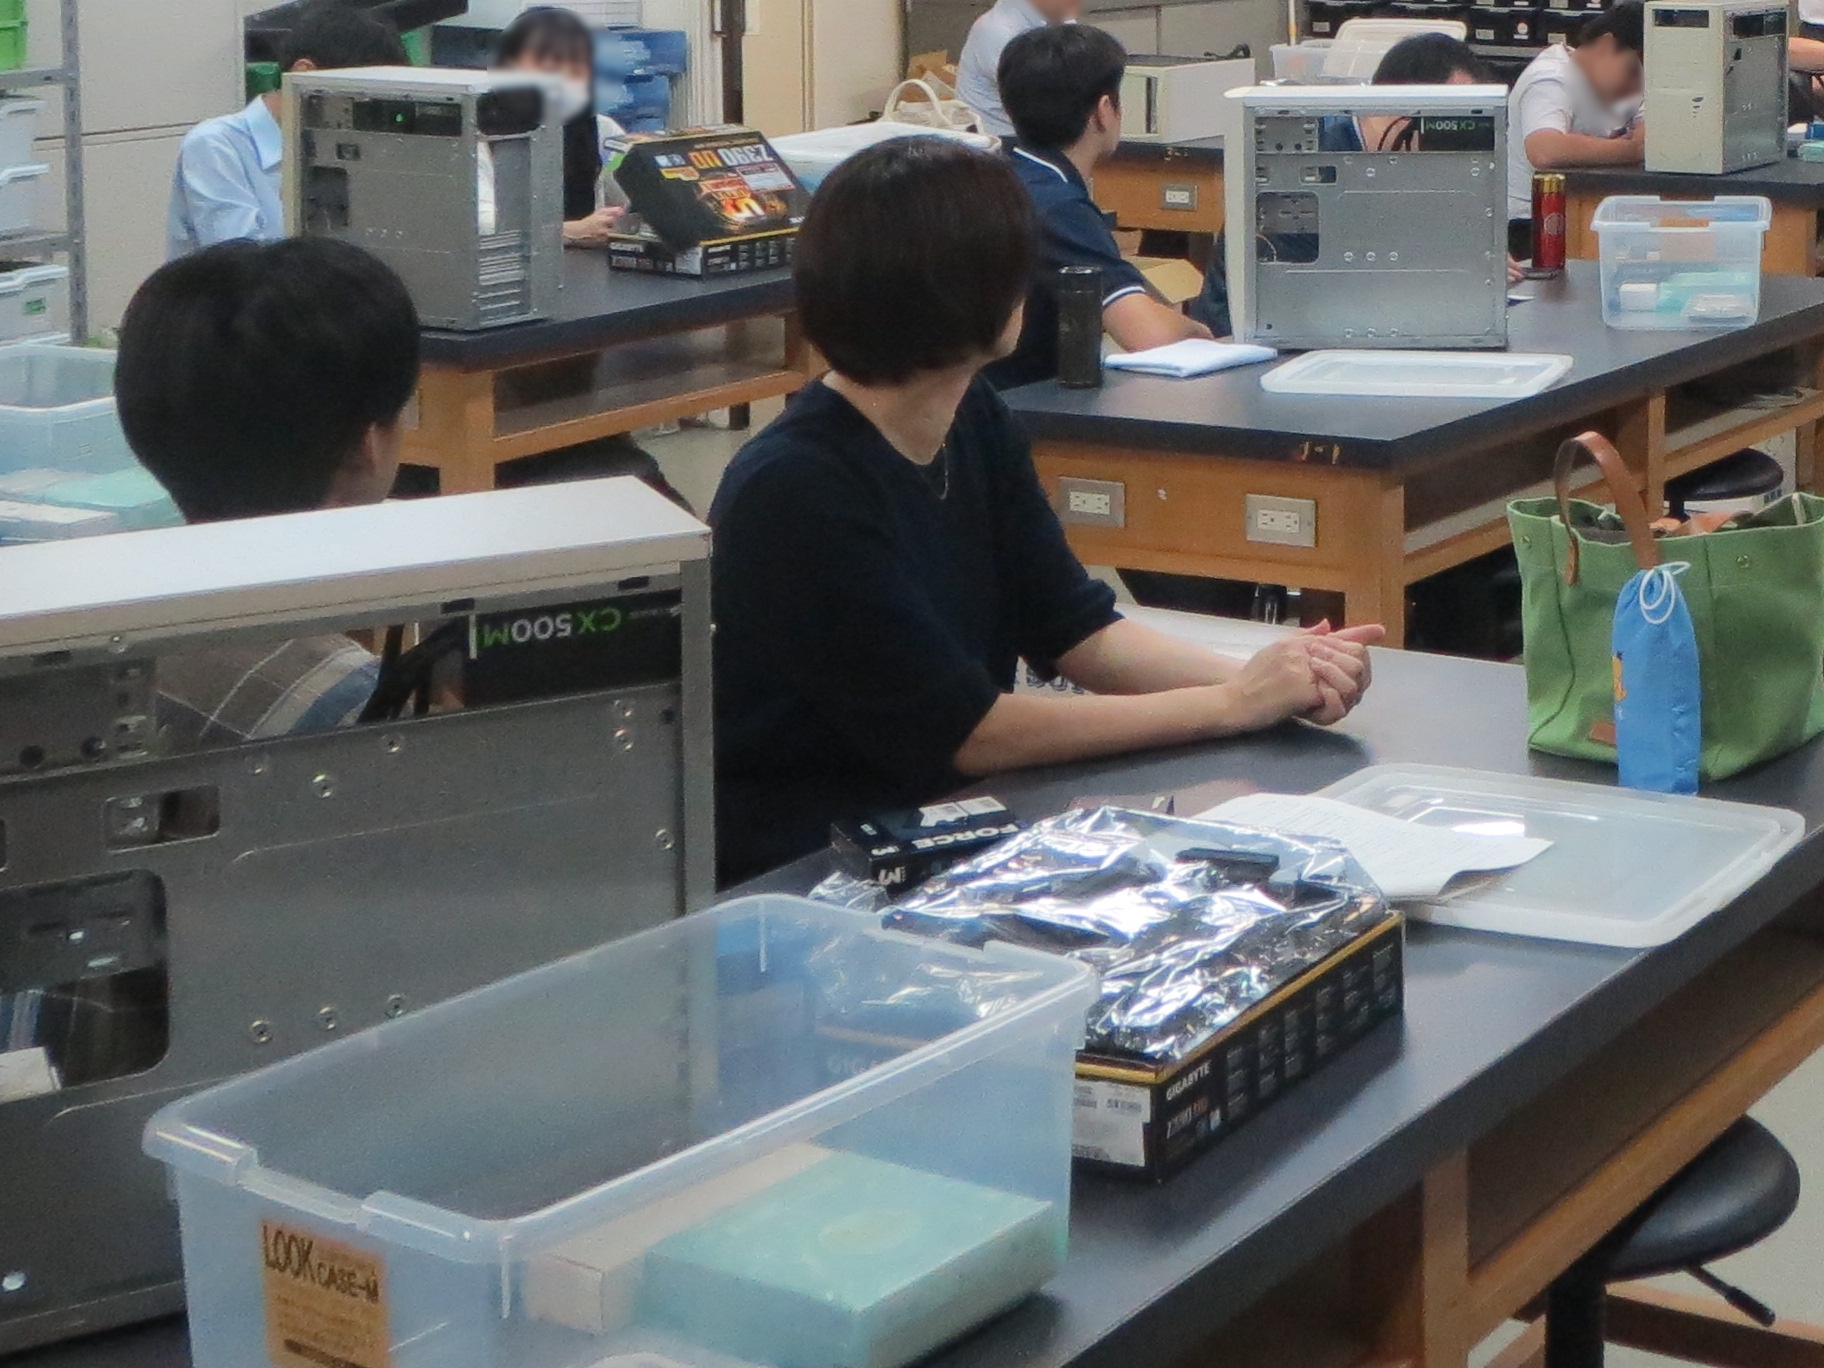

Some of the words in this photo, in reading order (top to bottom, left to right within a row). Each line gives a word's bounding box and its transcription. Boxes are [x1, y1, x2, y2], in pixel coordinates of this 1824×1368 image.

[718, 143, 774, 167] Z390
[912, 823, 1019, 850] FORCE
[1165, 1059, 1212, 1101] GIGABYTE
[262, 1224, 317, 1285] LOOK
